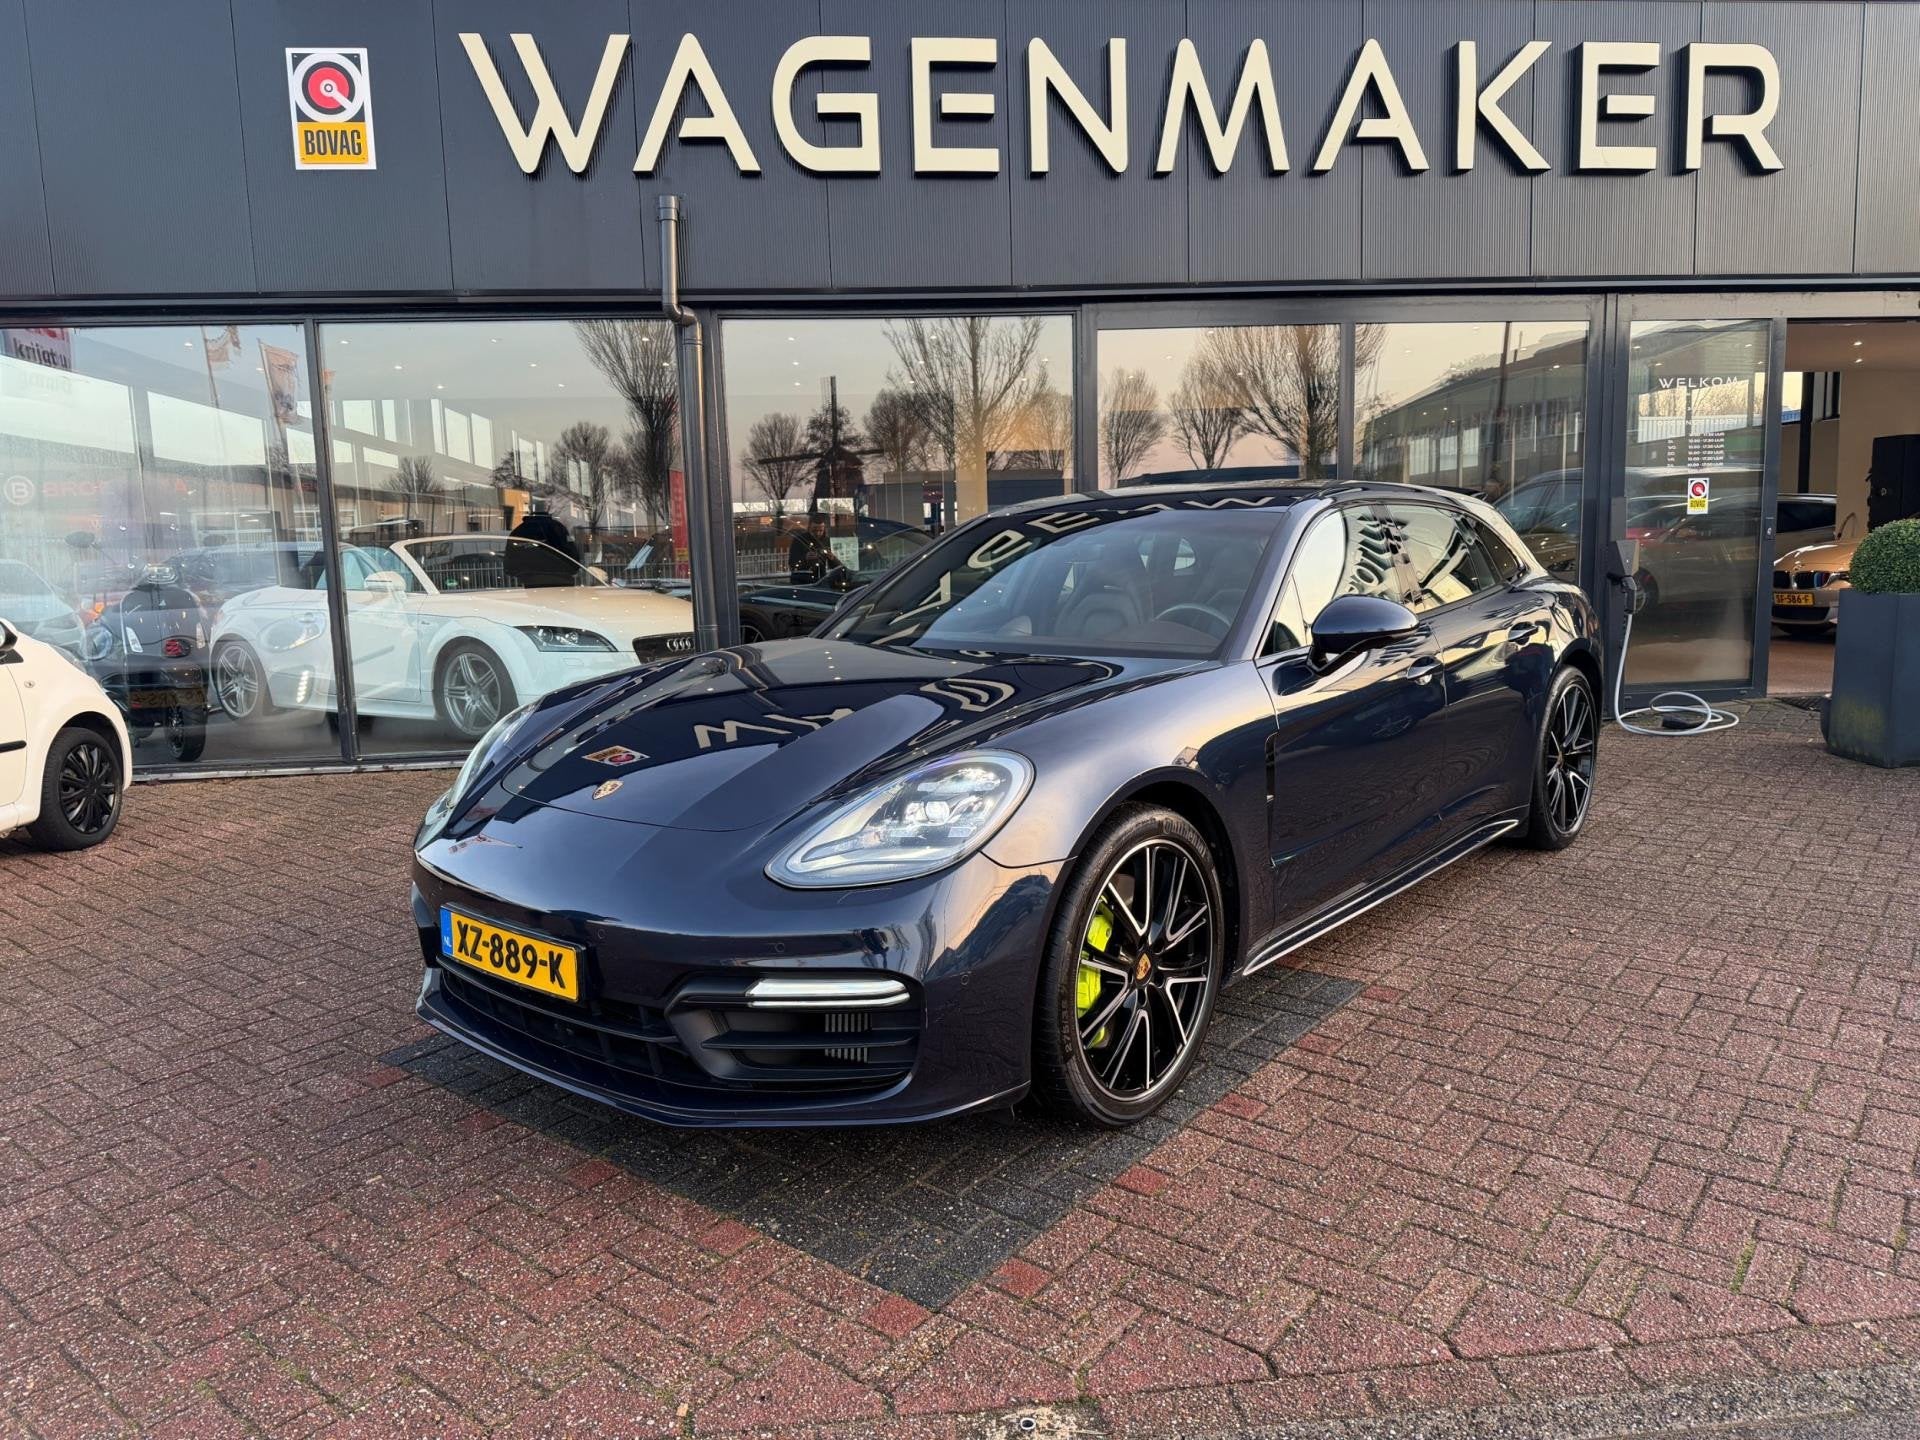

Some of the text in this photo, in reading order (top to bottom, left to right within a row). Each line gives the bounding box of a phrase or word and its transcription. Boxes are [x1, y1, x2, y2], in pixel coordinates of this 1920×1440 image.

[459, 33, 1784, 173] WAGENMAKER
[304, 129, 363, 156] BOVAG
[13, 337, 57, 368] krijgt
[1659, 376, 1738, 389] WELKOM
[443, 935, 452, 948] NL
[457, 920, 566, 989] XZ-889-K
